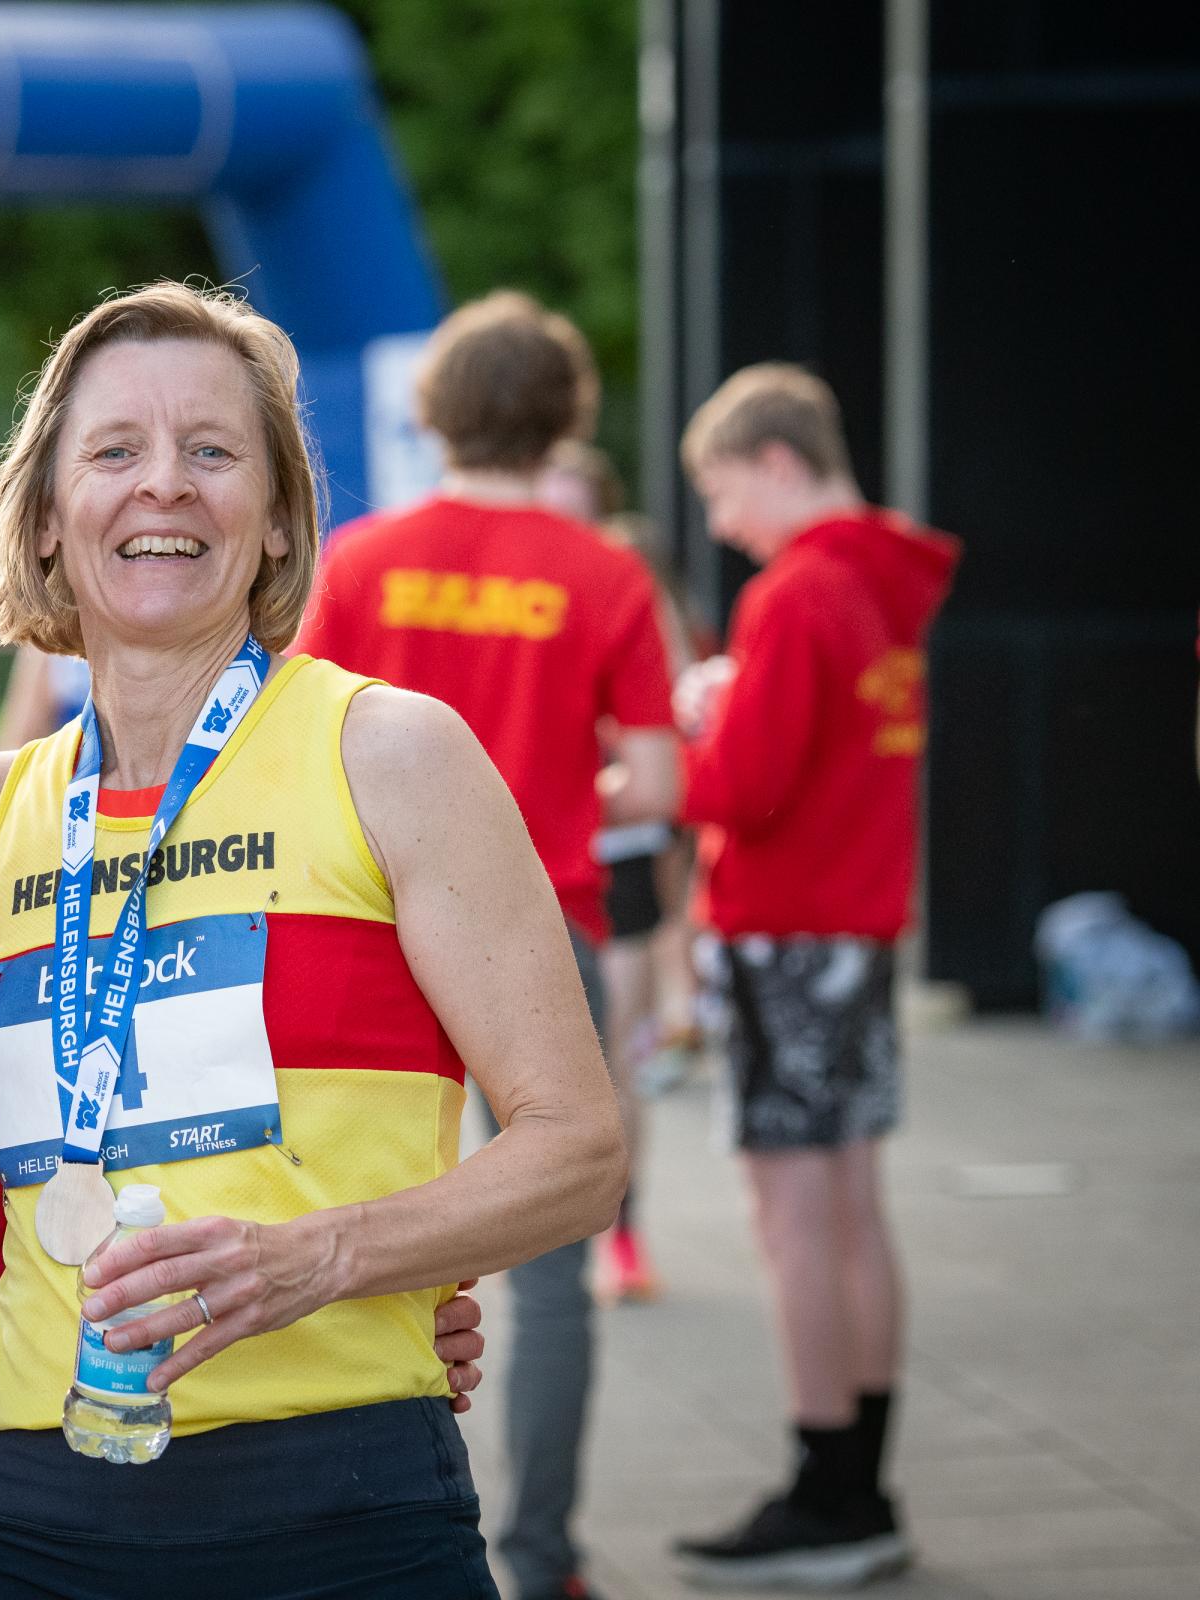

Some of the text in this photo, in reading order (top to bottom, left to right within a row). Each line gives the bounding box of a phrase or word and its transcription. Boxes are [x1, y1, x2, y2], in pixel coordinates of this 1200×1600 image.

[100, 864, 148, 1029] HELENSBUR
[59, 883, 81, 1069] HELENSBURGH
[170, 1123, 225, 1149] START
[195, 1138, 237, 1153] FITNESS
[18, 1143, 129, 1176] HELENRGH
[89, 1356, 153, 1374] spring wat
